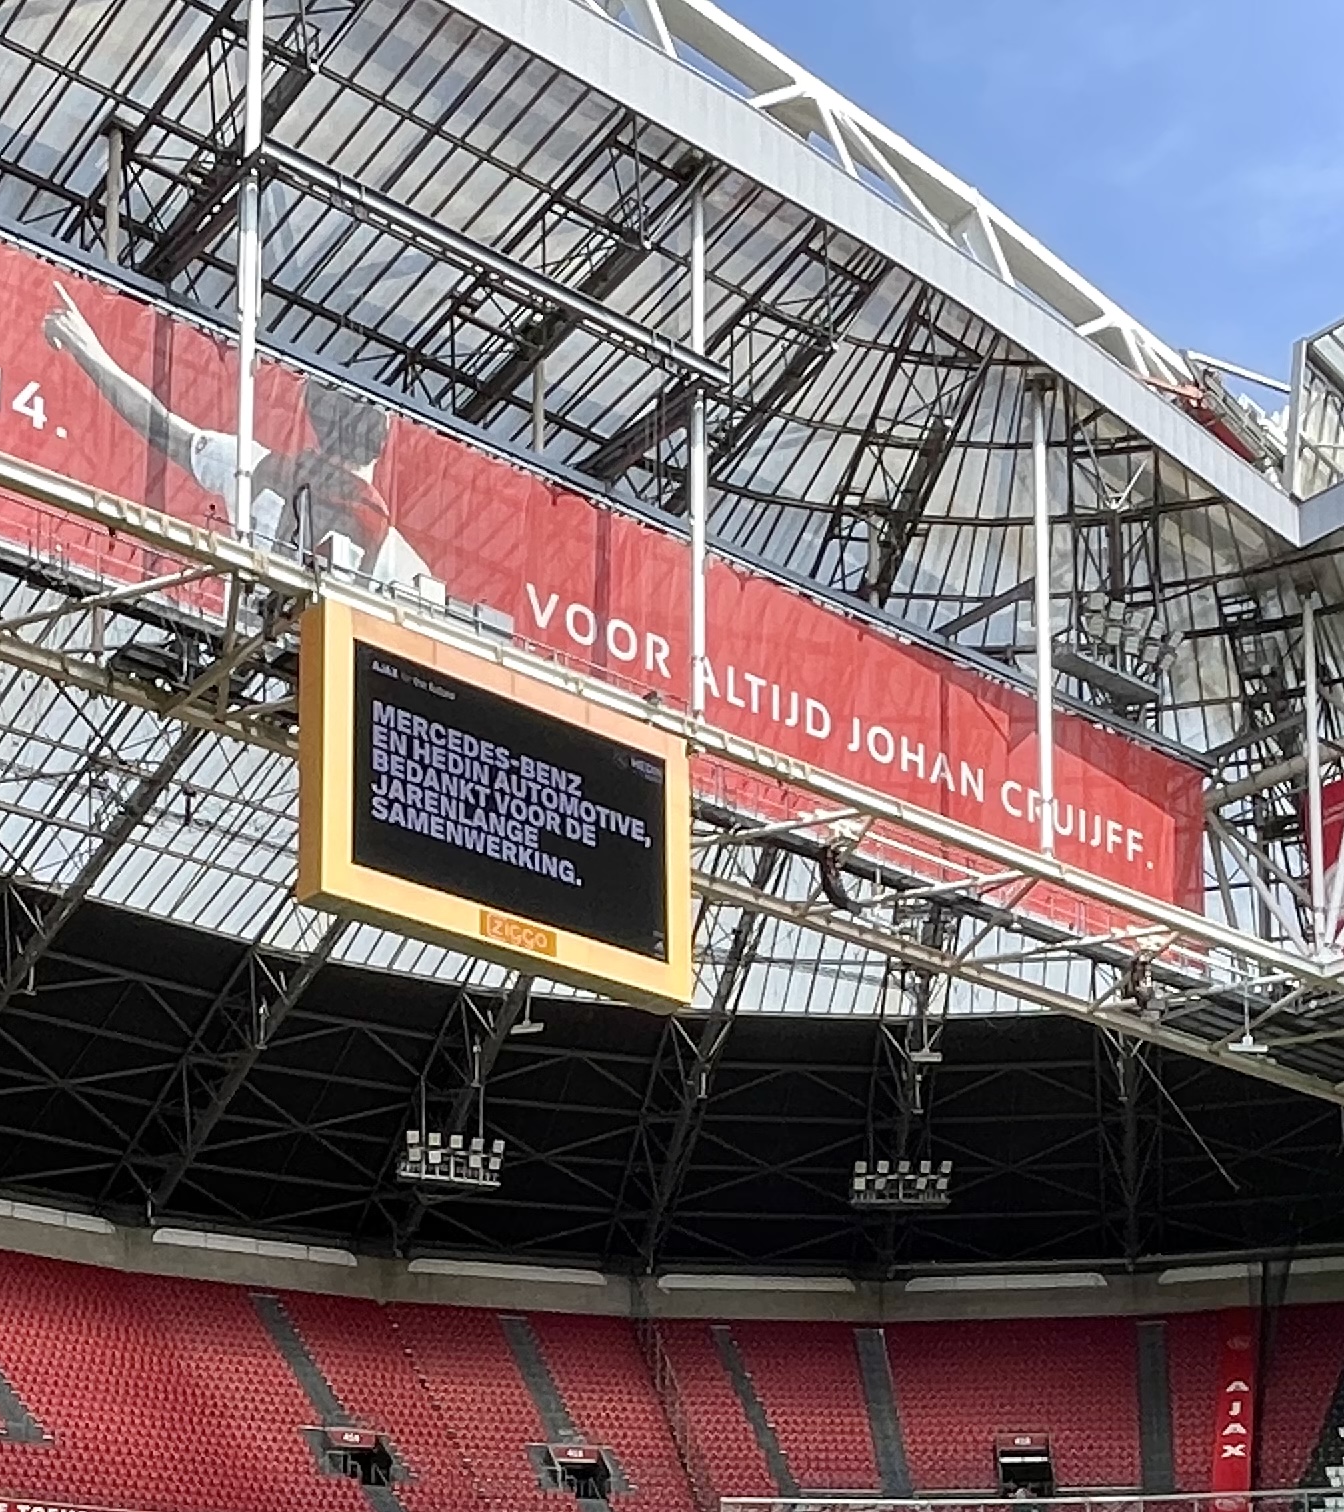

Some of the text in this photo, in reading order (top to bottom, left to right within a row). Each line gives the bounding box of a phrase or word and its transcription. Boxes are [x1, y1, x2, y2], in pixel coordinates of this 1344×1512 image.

[525, 582, 671, 678] VOOR
[702, 656, 833, 740] ALTIJD
[847, 716, 985, 801] JOHAN
[372, 700, 582, 798] MERCEDES-BENZ
[372, 724, 652, 848] EN HEDIN AUTOMOTIVE,
[372, 749, 597, 847] BEDANKT VOOR DE
[372, 774, 539, 849] JARENLANGE
[372, 797, 582, 886] SAMENWERKING.
[1220, 1380, 1250, 1458] AJAX
